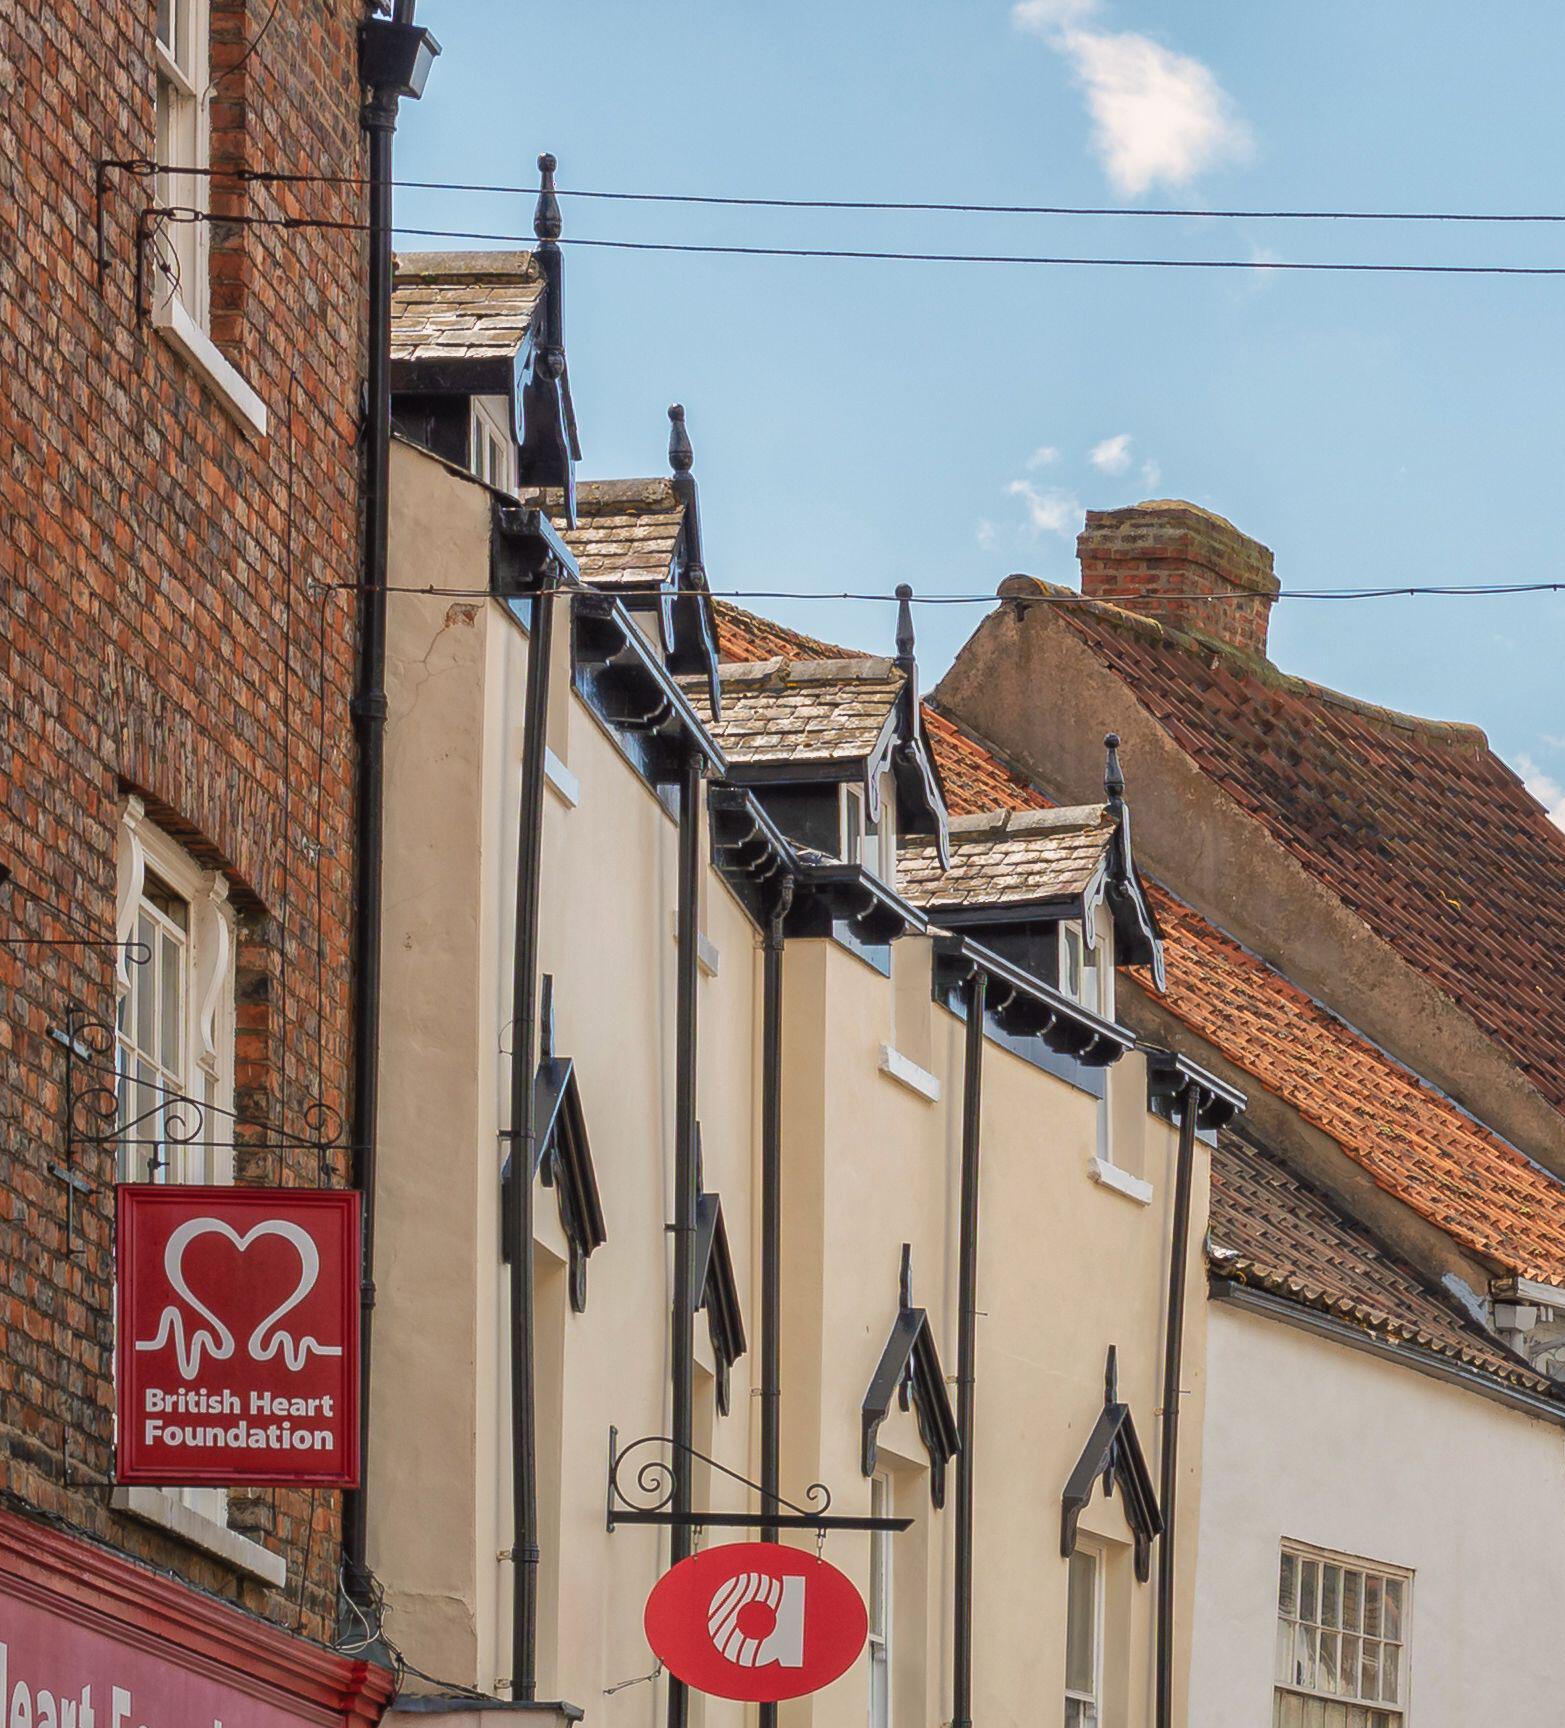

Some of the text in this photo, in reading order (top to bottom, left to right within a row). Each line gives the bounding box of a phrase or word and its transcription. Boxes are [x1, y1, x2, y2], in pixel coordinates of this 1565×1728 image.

[144, 1387, 334, 1418] British Heart
[144, 1419, 334, 1451] Foundation
